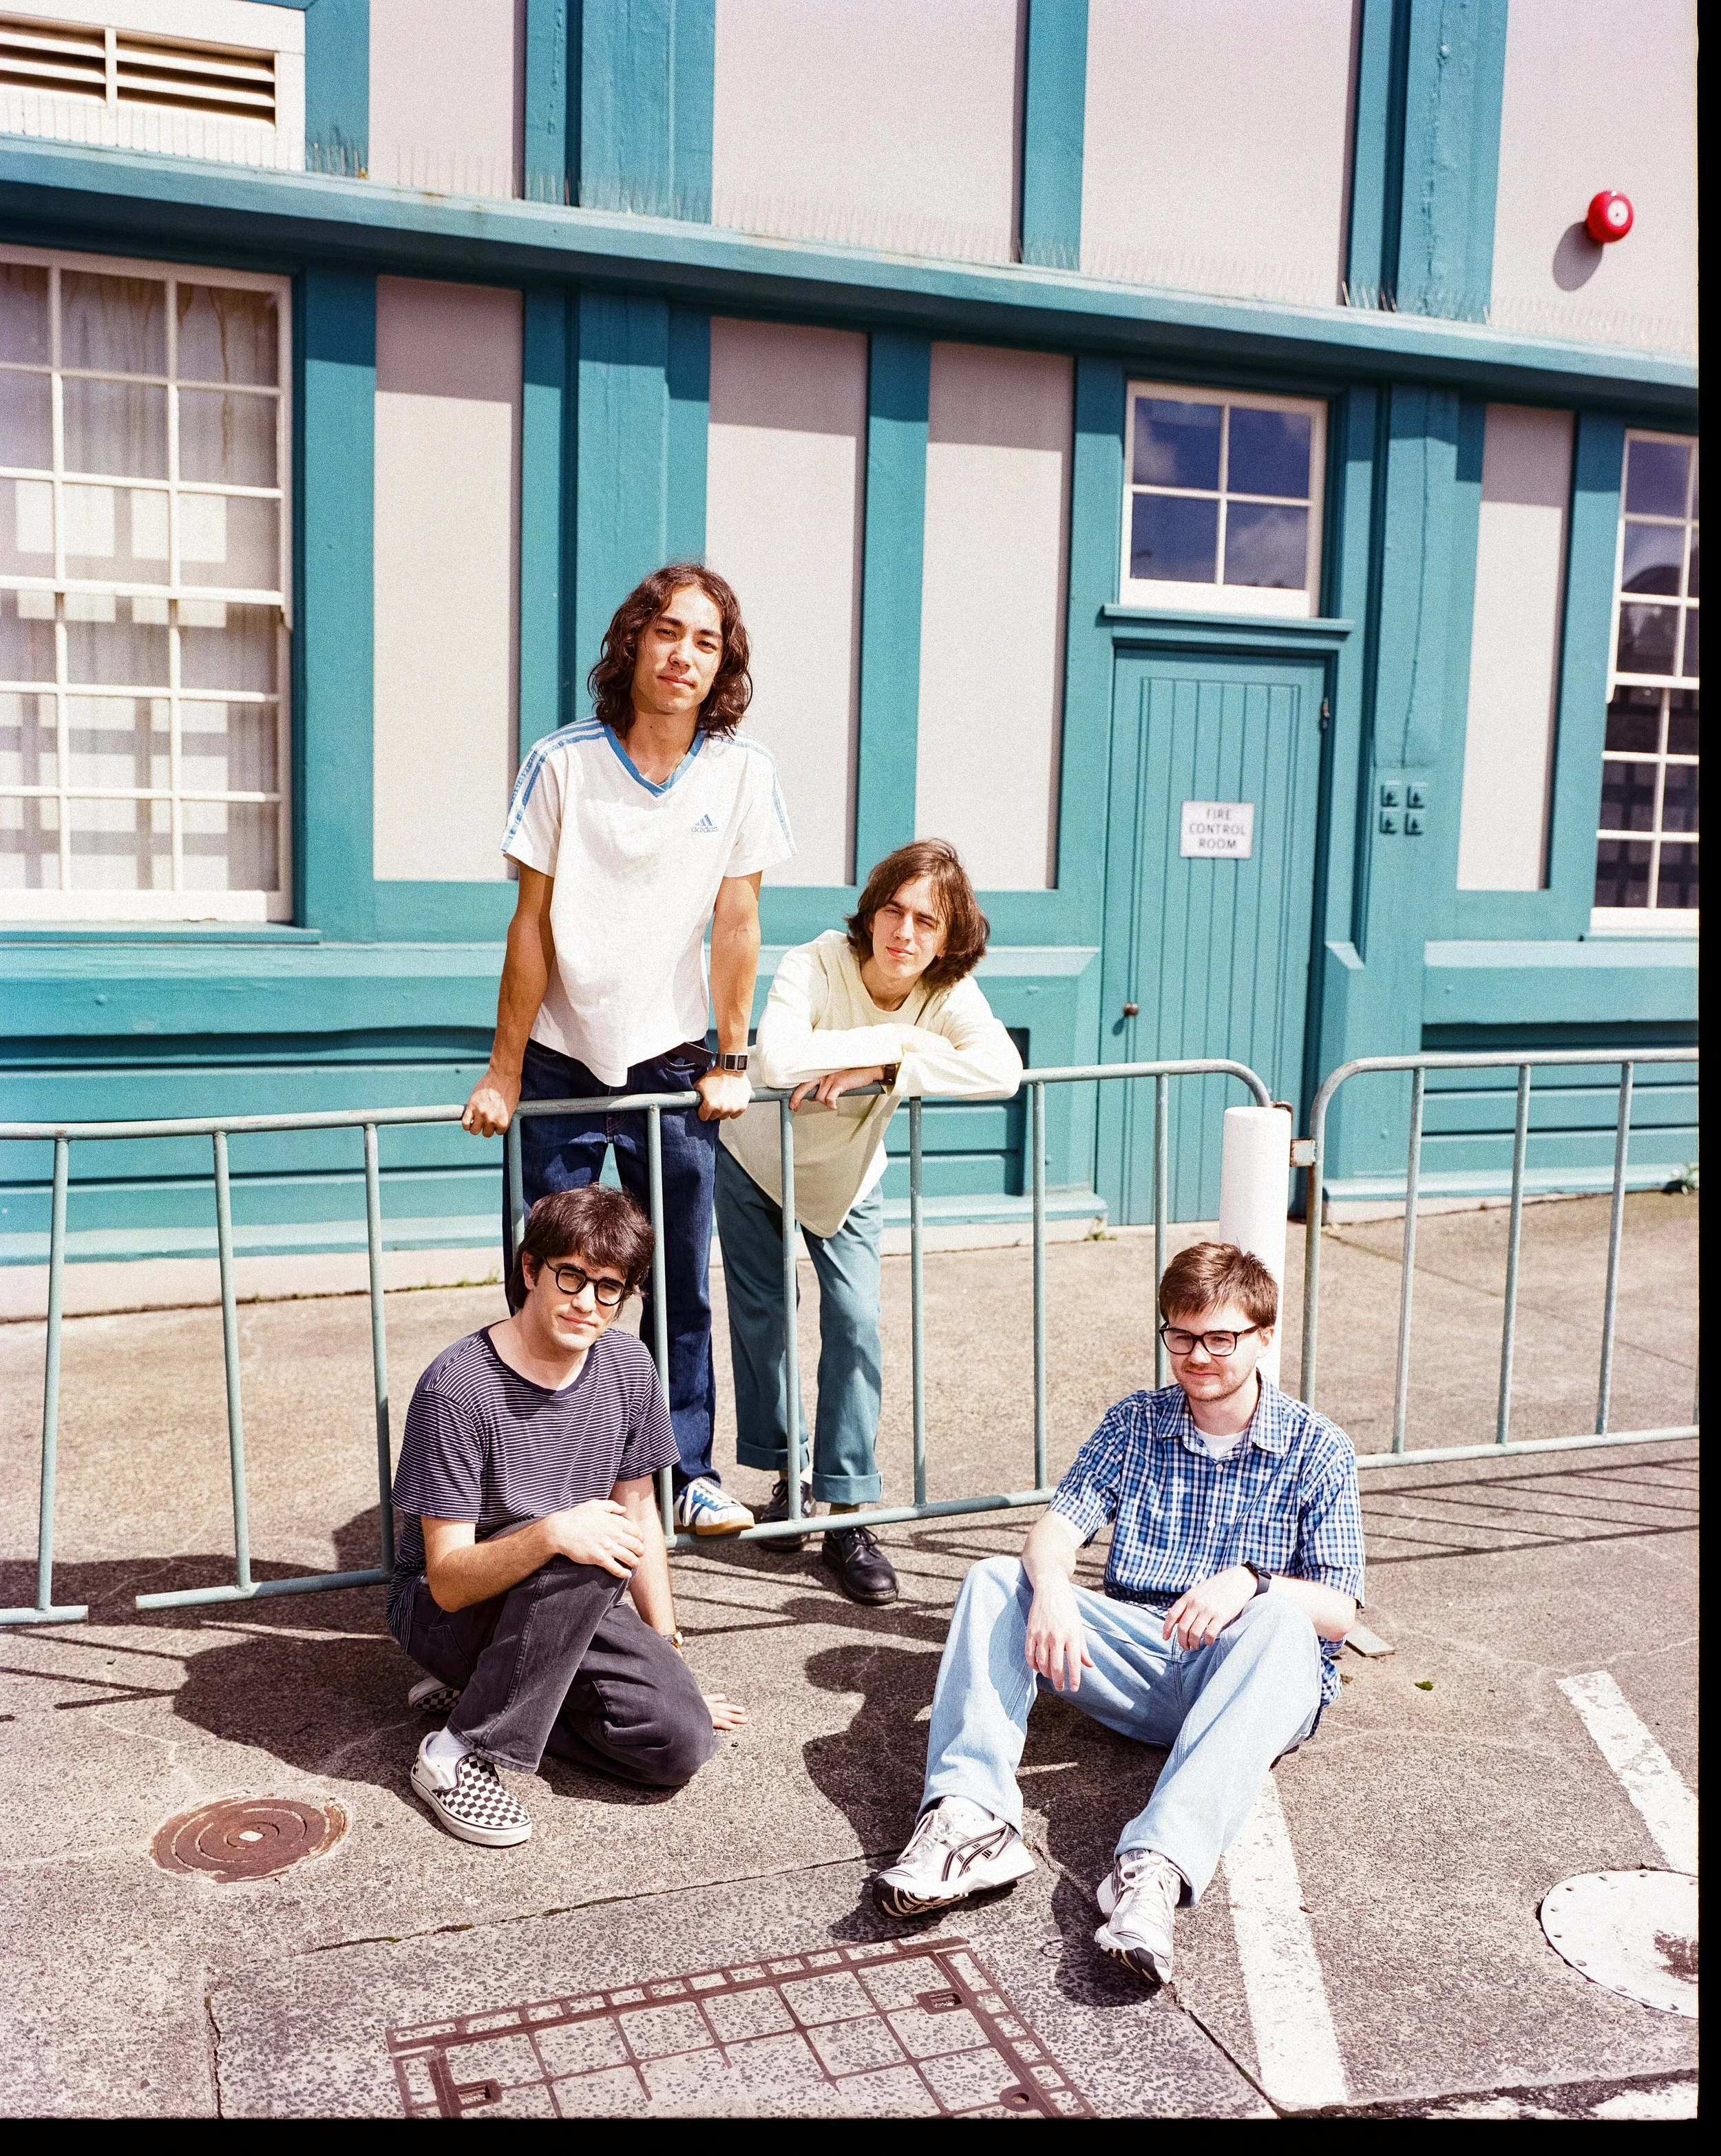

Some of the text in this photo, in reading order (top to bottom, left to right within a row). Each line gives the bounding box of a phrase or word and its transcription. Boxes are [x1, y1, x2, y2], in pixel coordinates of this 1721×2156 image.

[1206, 808, 1232, 820] FIRE
[690, 825, 718, 833] adidas
[1189, 822, 1245, 836] CONTROL
[1199, 837, 1236, 849] ROOM
